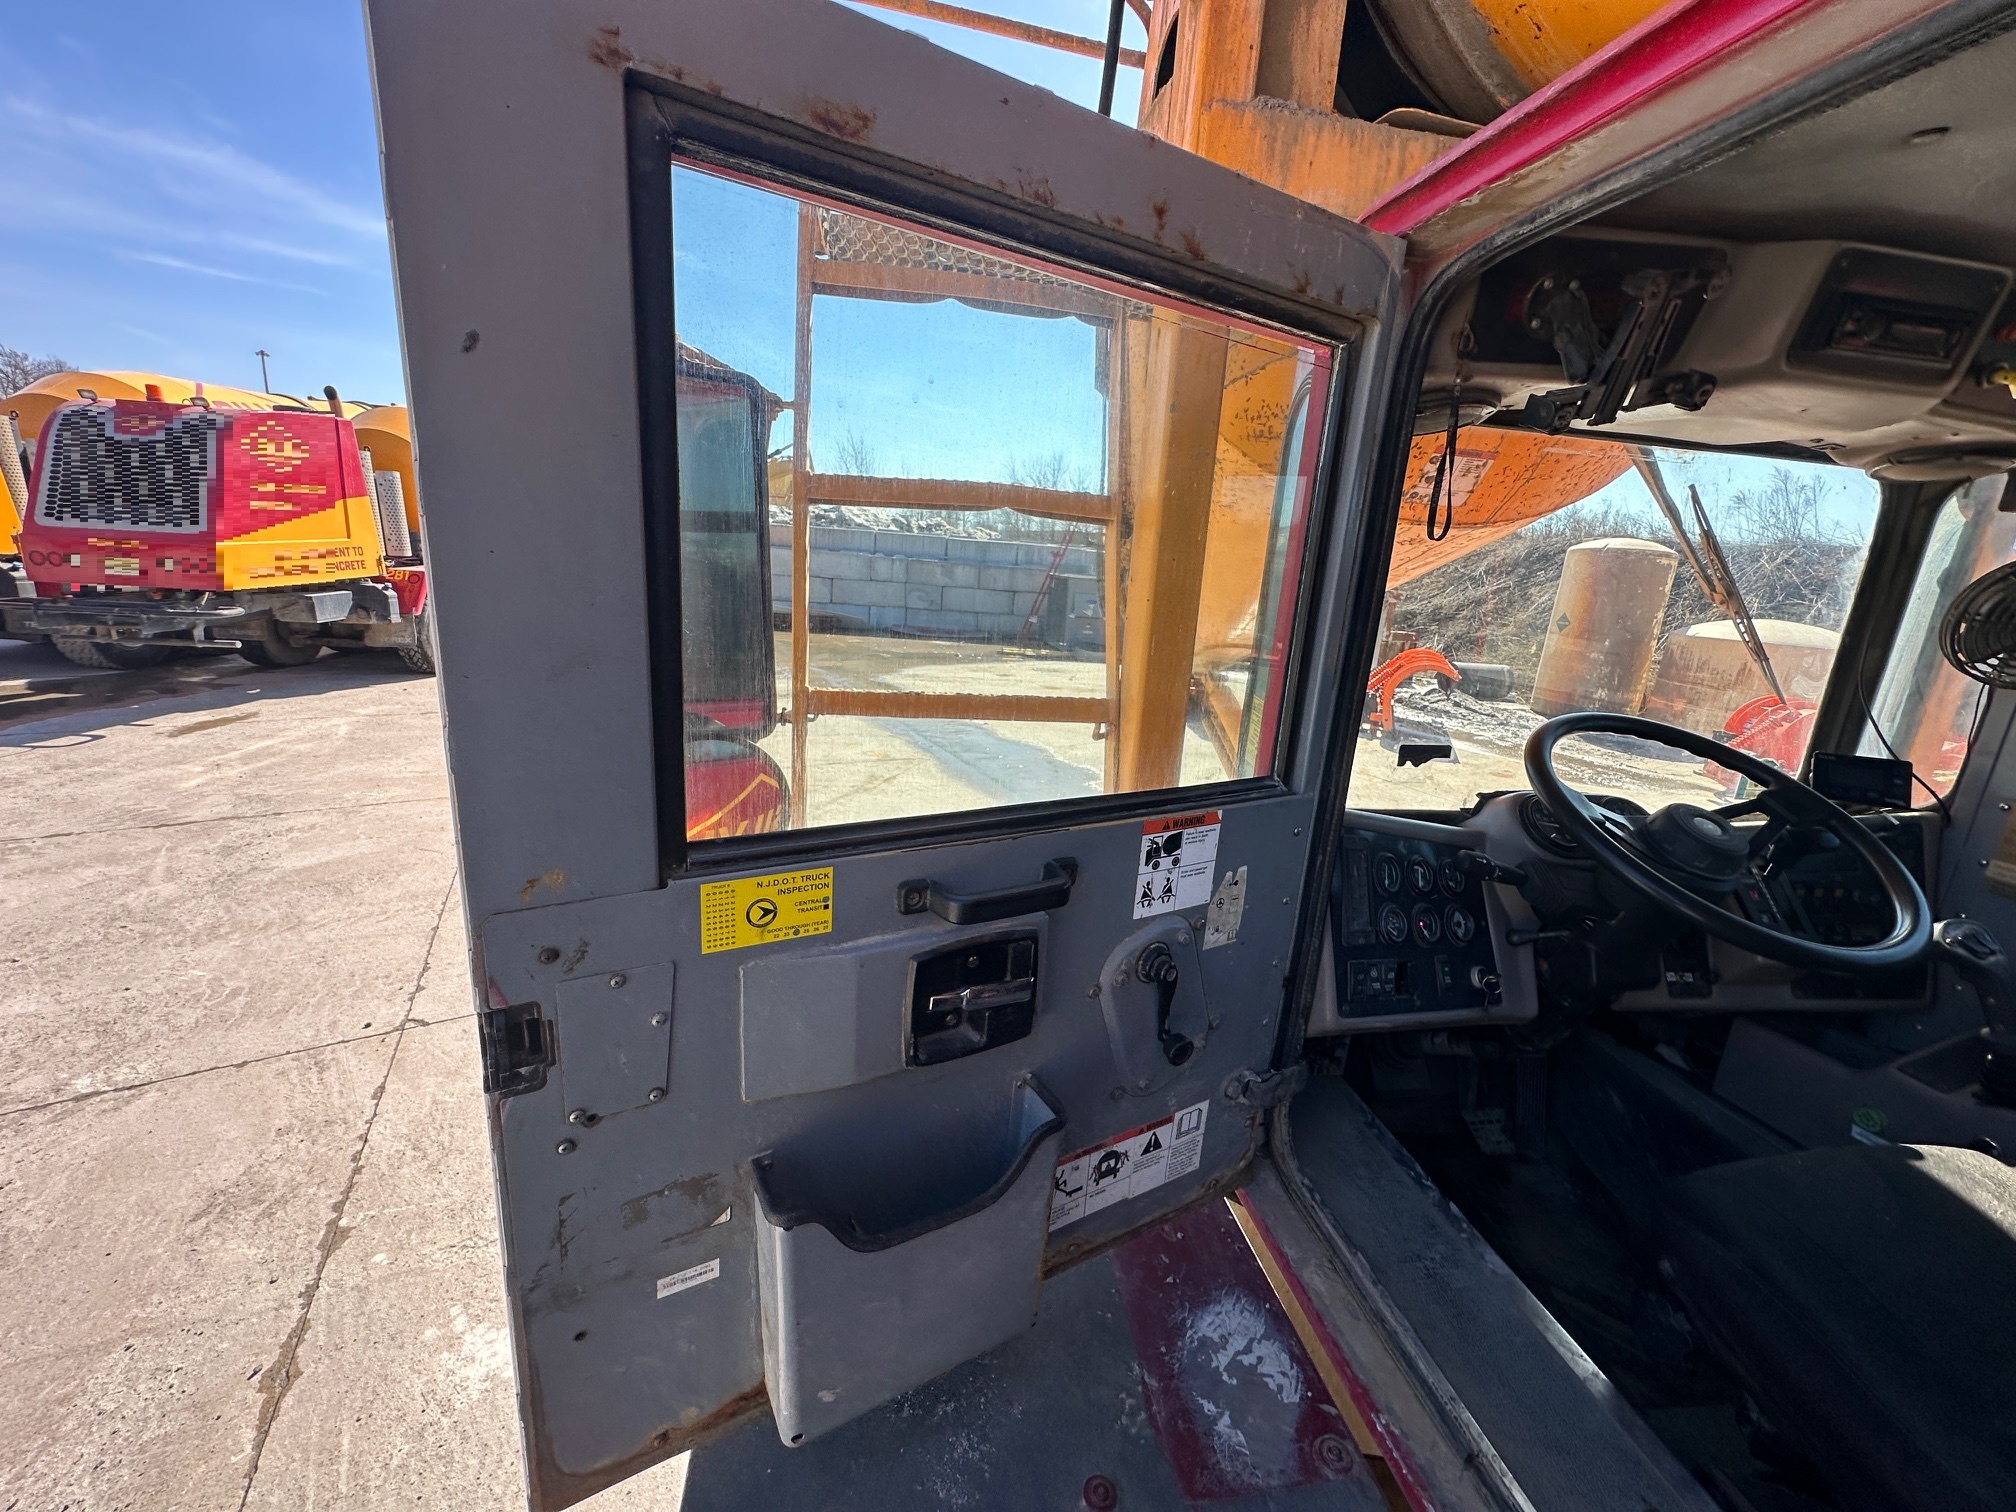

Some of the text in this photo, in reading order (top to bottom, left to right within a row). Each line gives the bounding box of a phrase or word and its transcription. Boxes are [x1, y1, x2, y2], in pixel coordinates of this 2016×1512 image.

[353, 546, 364, 556] TO
[1172, 815, 1206, 828] WARNING
[756, 872, 830, 888] N.J.D.O.T. TRUCK
[777, 882, 830, 896] INSPECTION
[794, 898, 823, 907] CENTRAL
[797, 905, 823, 913] TRANSIT
[811, 920, 830, 928] (YEAR)
